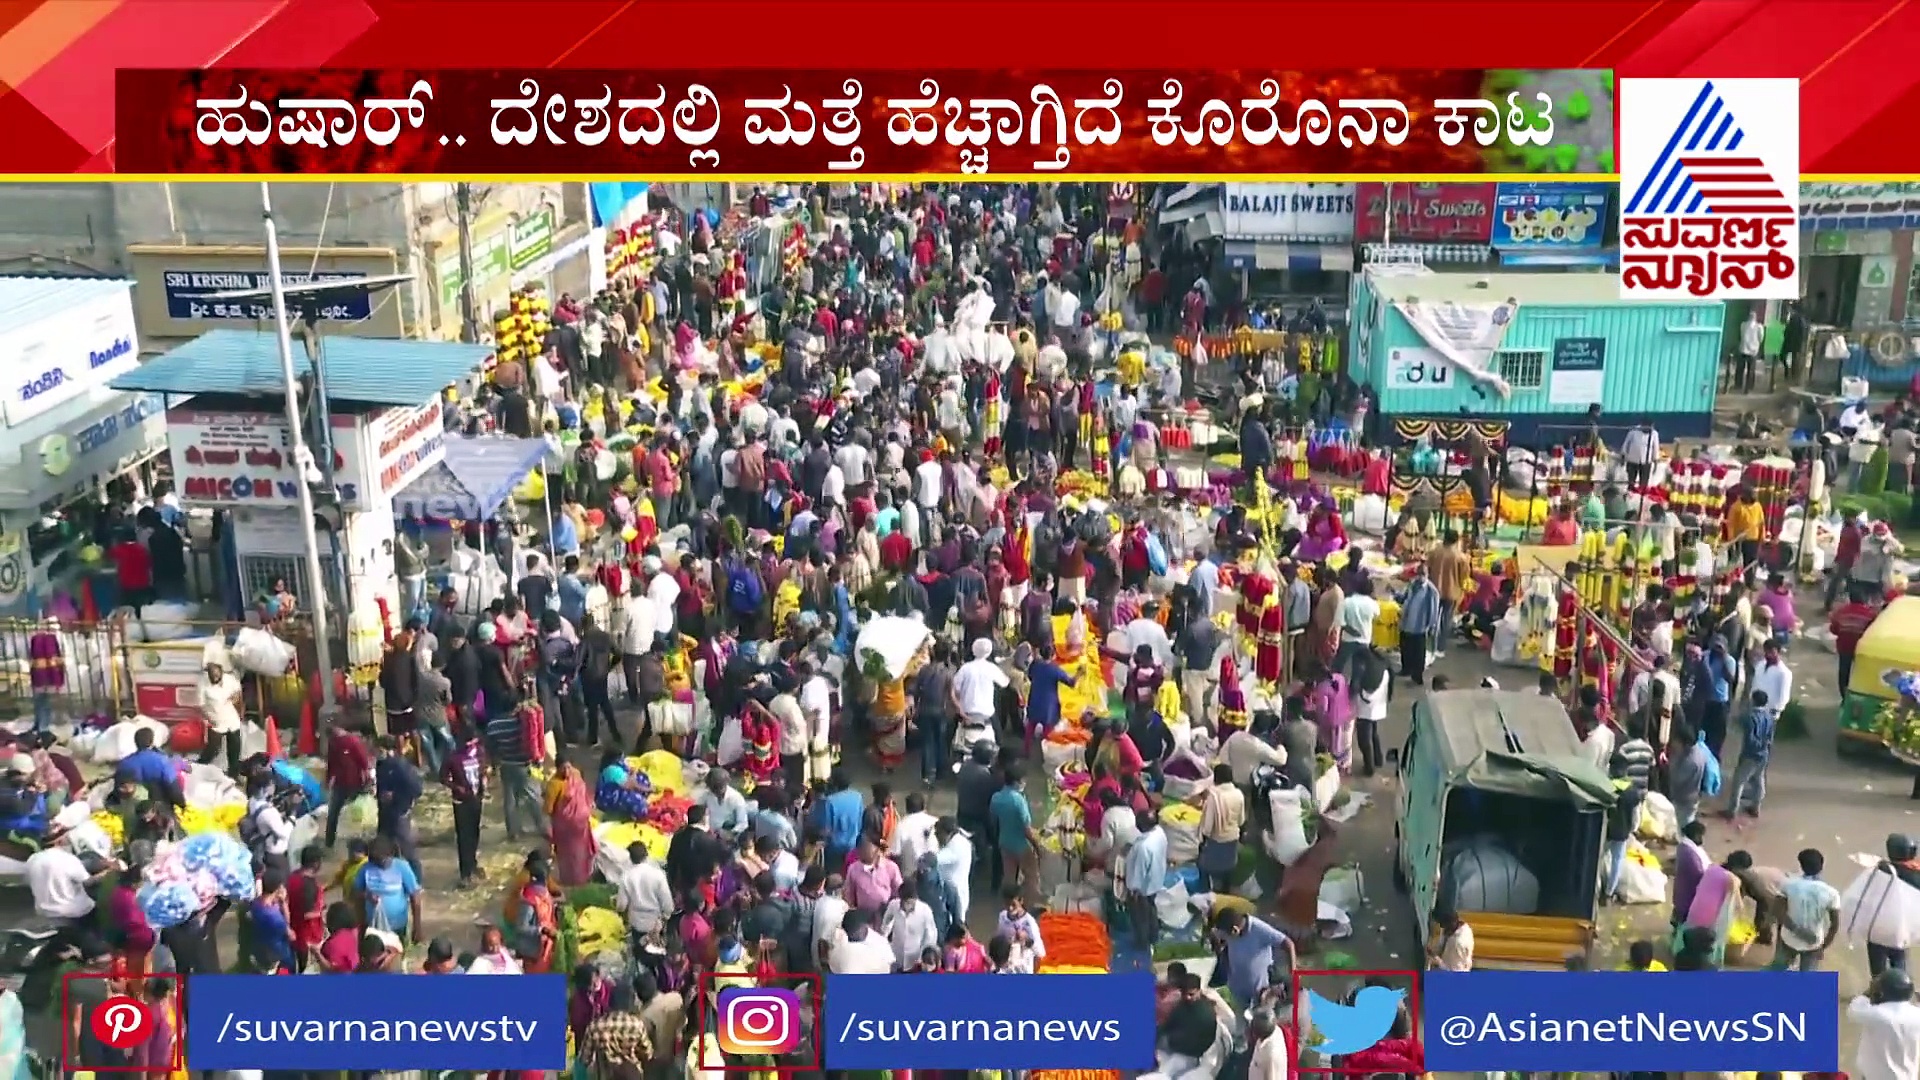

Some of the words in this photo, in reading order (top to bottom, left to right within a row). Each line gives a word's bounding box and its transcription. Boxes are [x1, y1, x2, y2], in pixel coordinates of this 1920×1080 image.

[1230, 194, 1286, 216] BALAJI
[1291, 193, 1353, 214] SWEETS
[166, 273, 189, 287] SRI
[192, 274, 250, 289] KRISHNA
